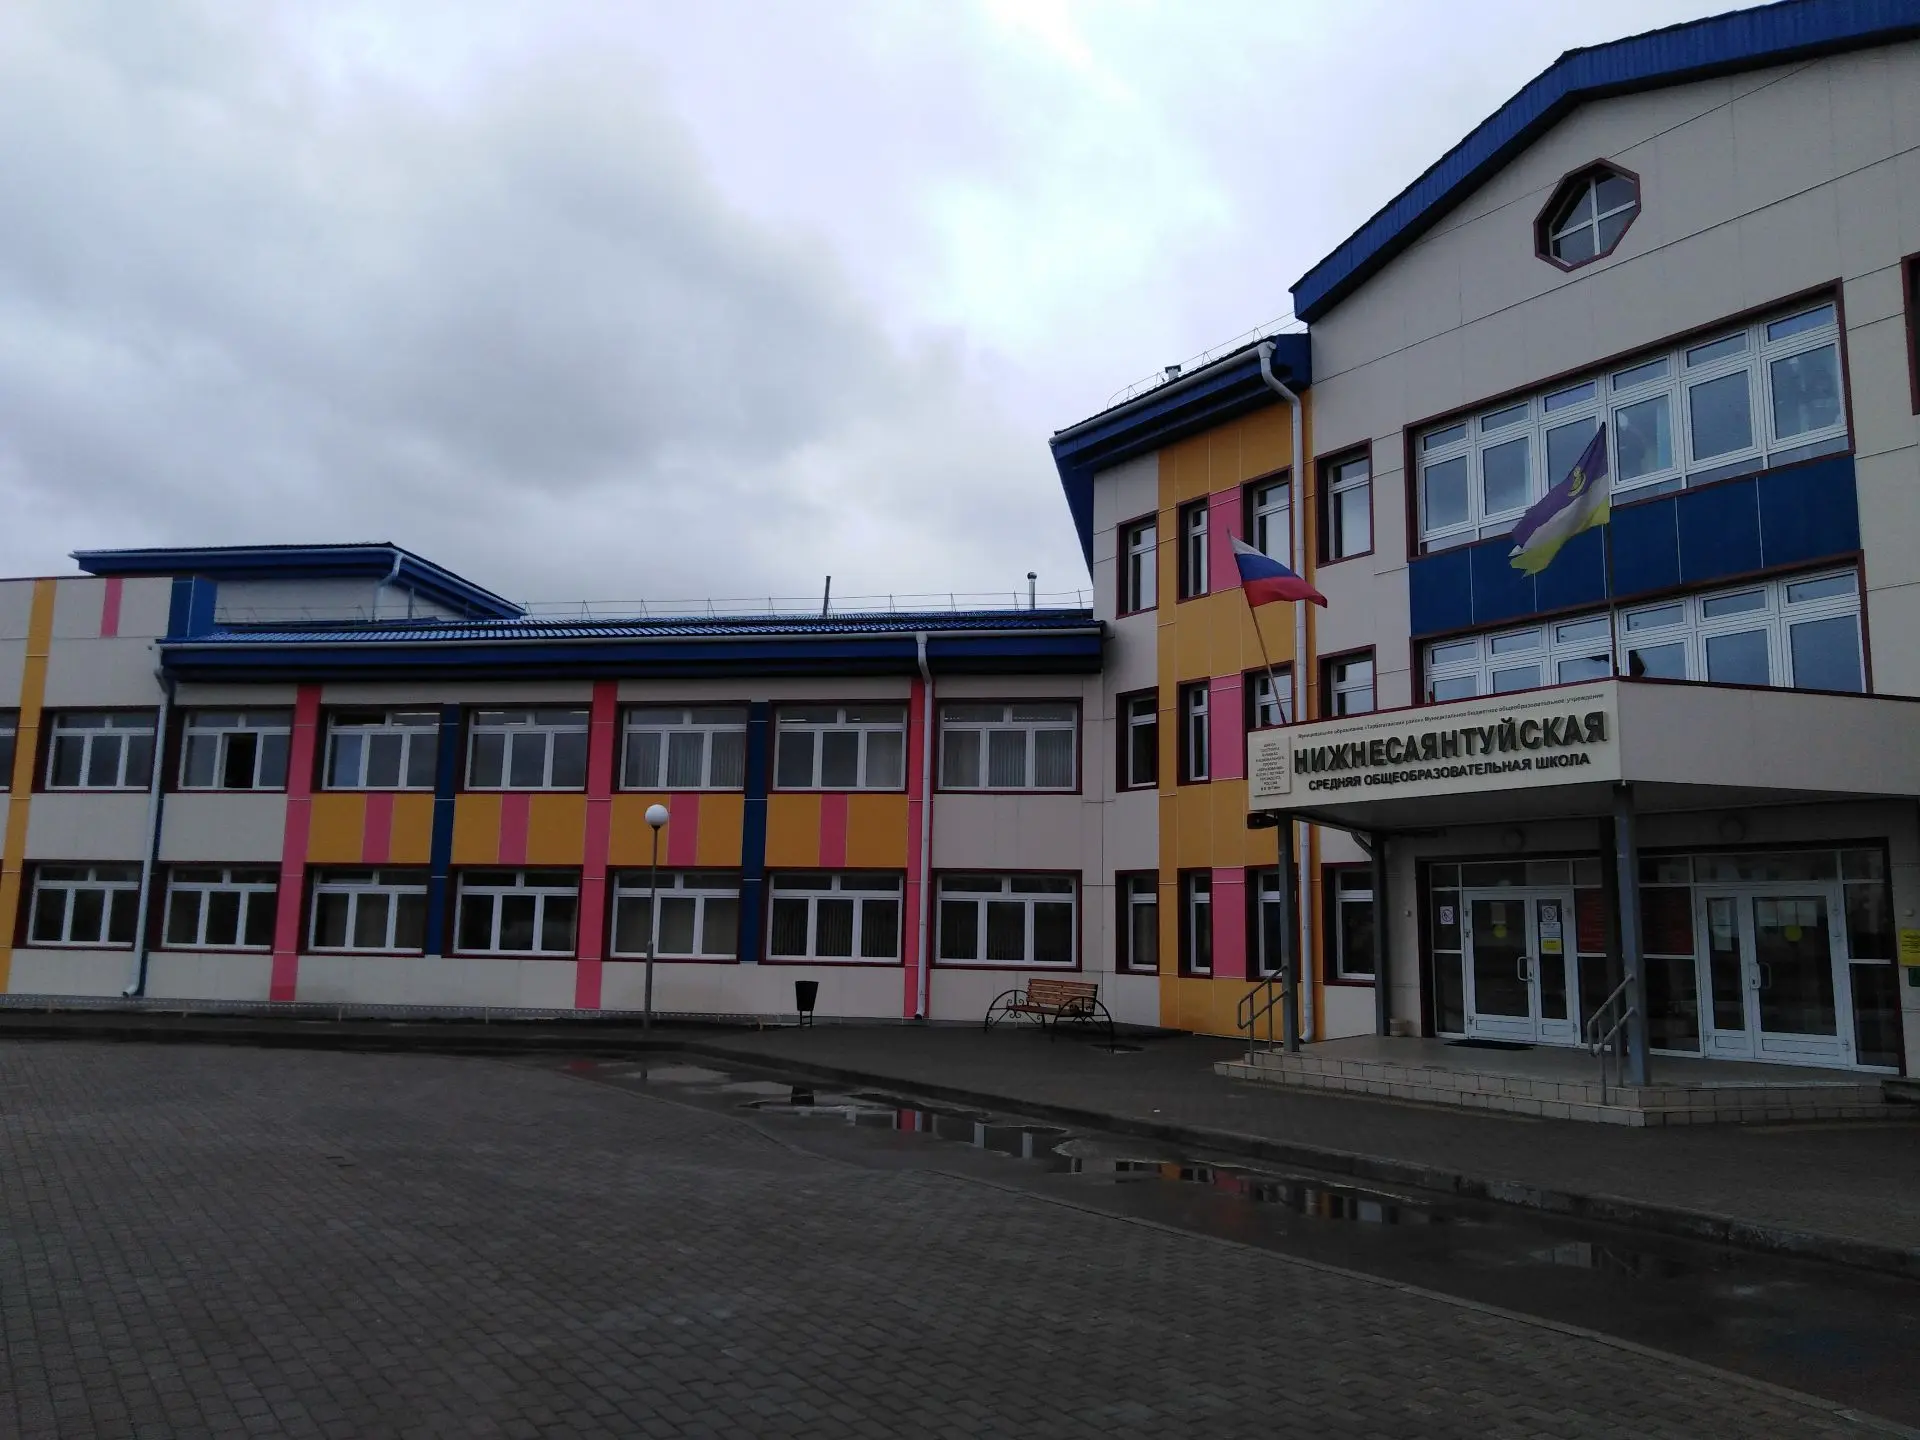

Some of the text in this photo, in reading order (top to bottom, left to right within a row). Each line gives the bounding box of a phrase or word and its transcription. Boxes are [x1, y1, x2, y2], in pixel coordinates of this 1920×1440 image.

[1499, 698, 1565, 712] общеобразовательное
[1567, 693, 1605, 704] учреждение
[1294, 711, 1606, 774] НИЖНЕСАЯНТУЙСКАЯ
[1309, 752, 1590, 791] СРЕДНЯЯ ОБЩЕОБРАЗОВАТЕЛЬНАЯ ШКОЛА
